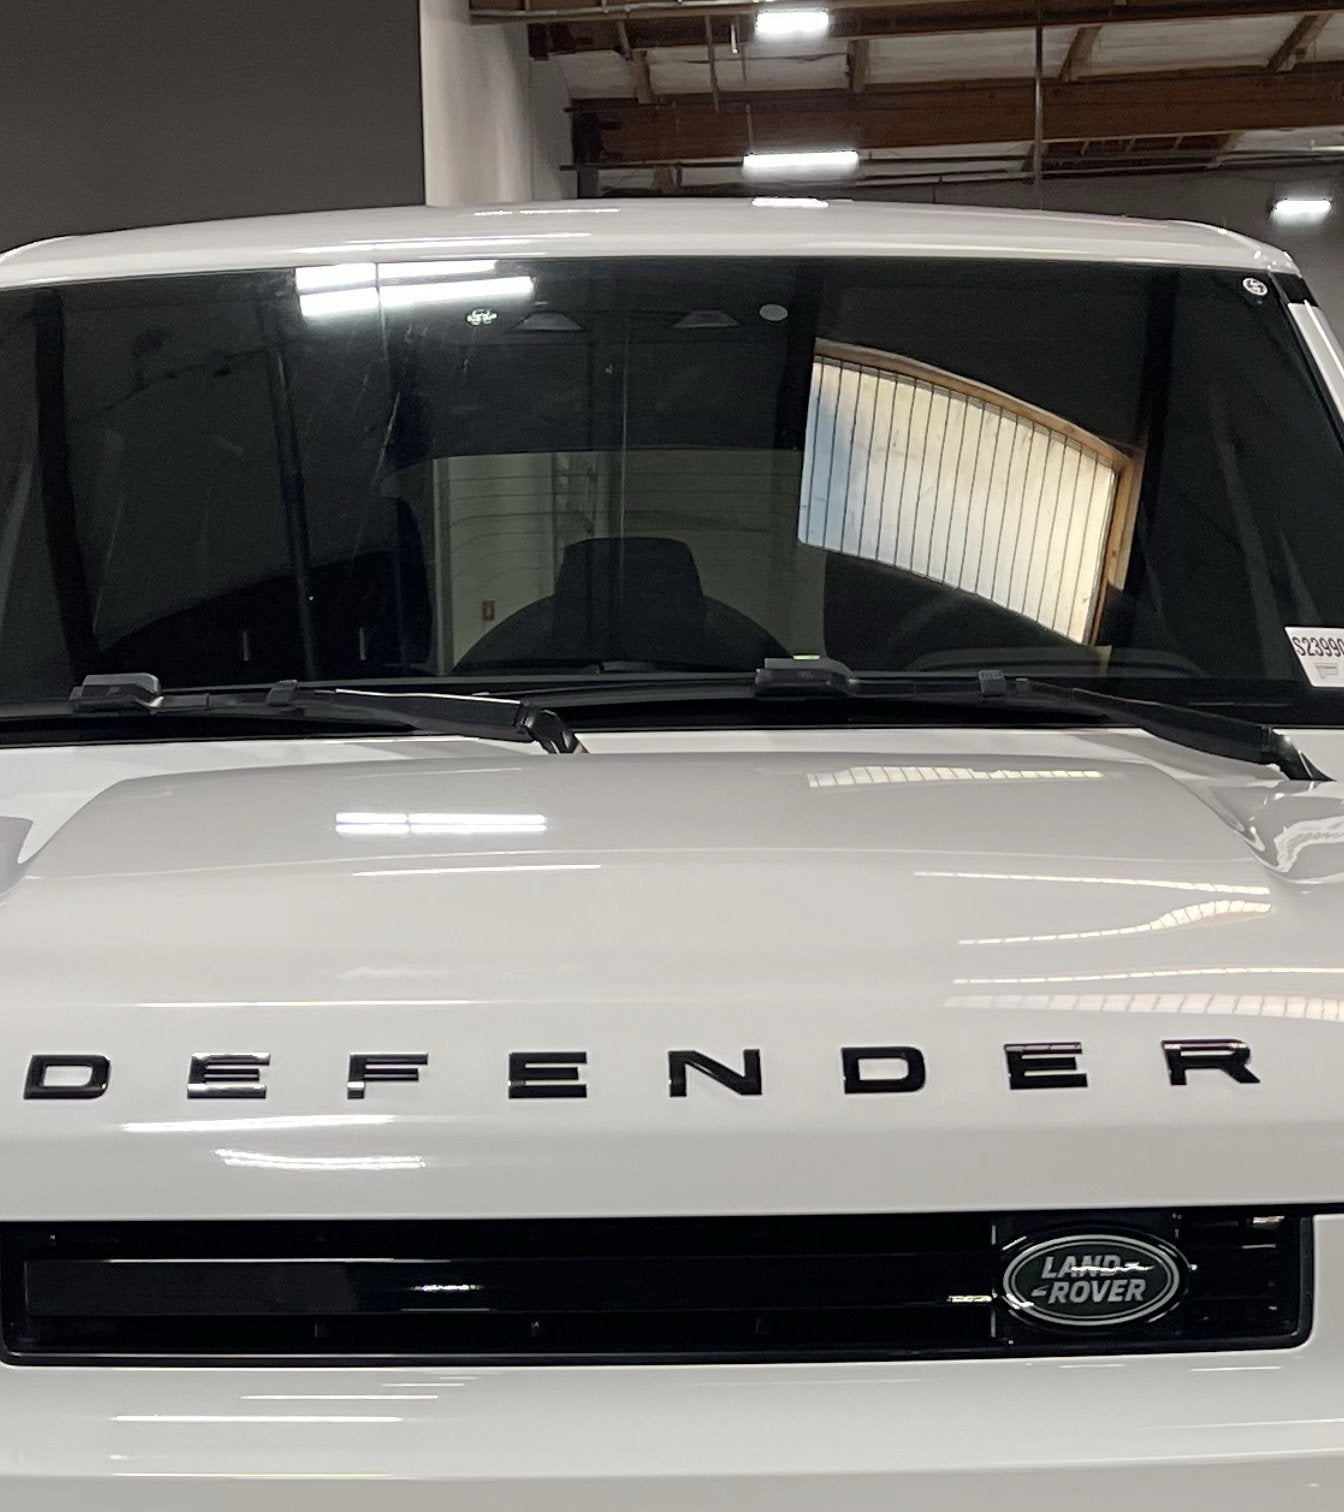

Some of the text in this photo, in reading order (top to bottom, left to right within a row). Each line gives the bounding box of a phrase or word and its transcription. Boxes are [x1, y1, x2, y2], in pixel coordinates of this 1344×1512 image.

[22, 1037, 1263, 1100] DEFENDER
[1041, 1254, 1122, 1280] LAND
[1047, 1278, 1147, 1304] ROVER
